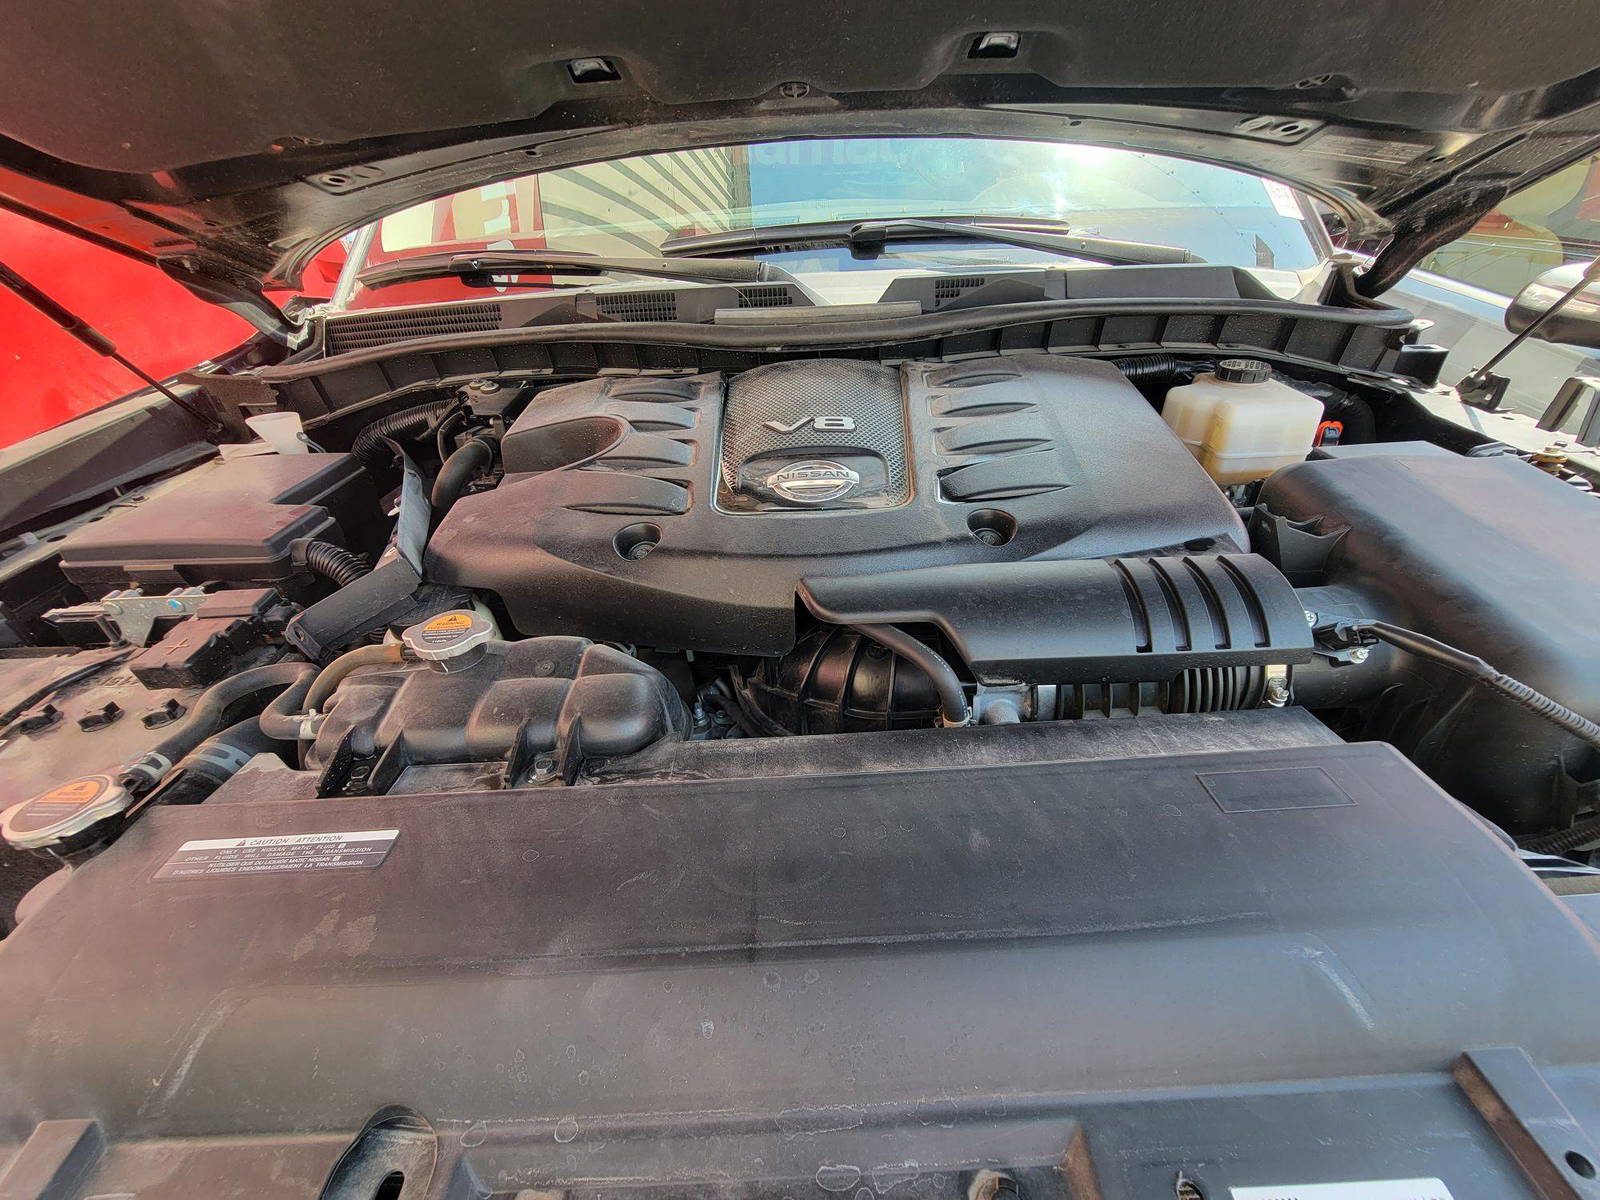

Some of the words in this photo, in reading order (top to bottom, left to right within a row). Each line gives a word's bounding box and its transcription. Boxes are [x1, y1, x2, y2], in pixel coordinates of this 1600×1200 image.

[762, 416, 857, 434] V8
[777, 470, 850, 482] NISSAN
[249, 838, 290, 846] CAUTION
[295, 835, 344, 843] ATTENTION
[266, 850, 296, 858] DAMAGE
[321, 847, 373, 855] TRANSMISSION
[316, 860, 364, 868] TRANSMISSION
